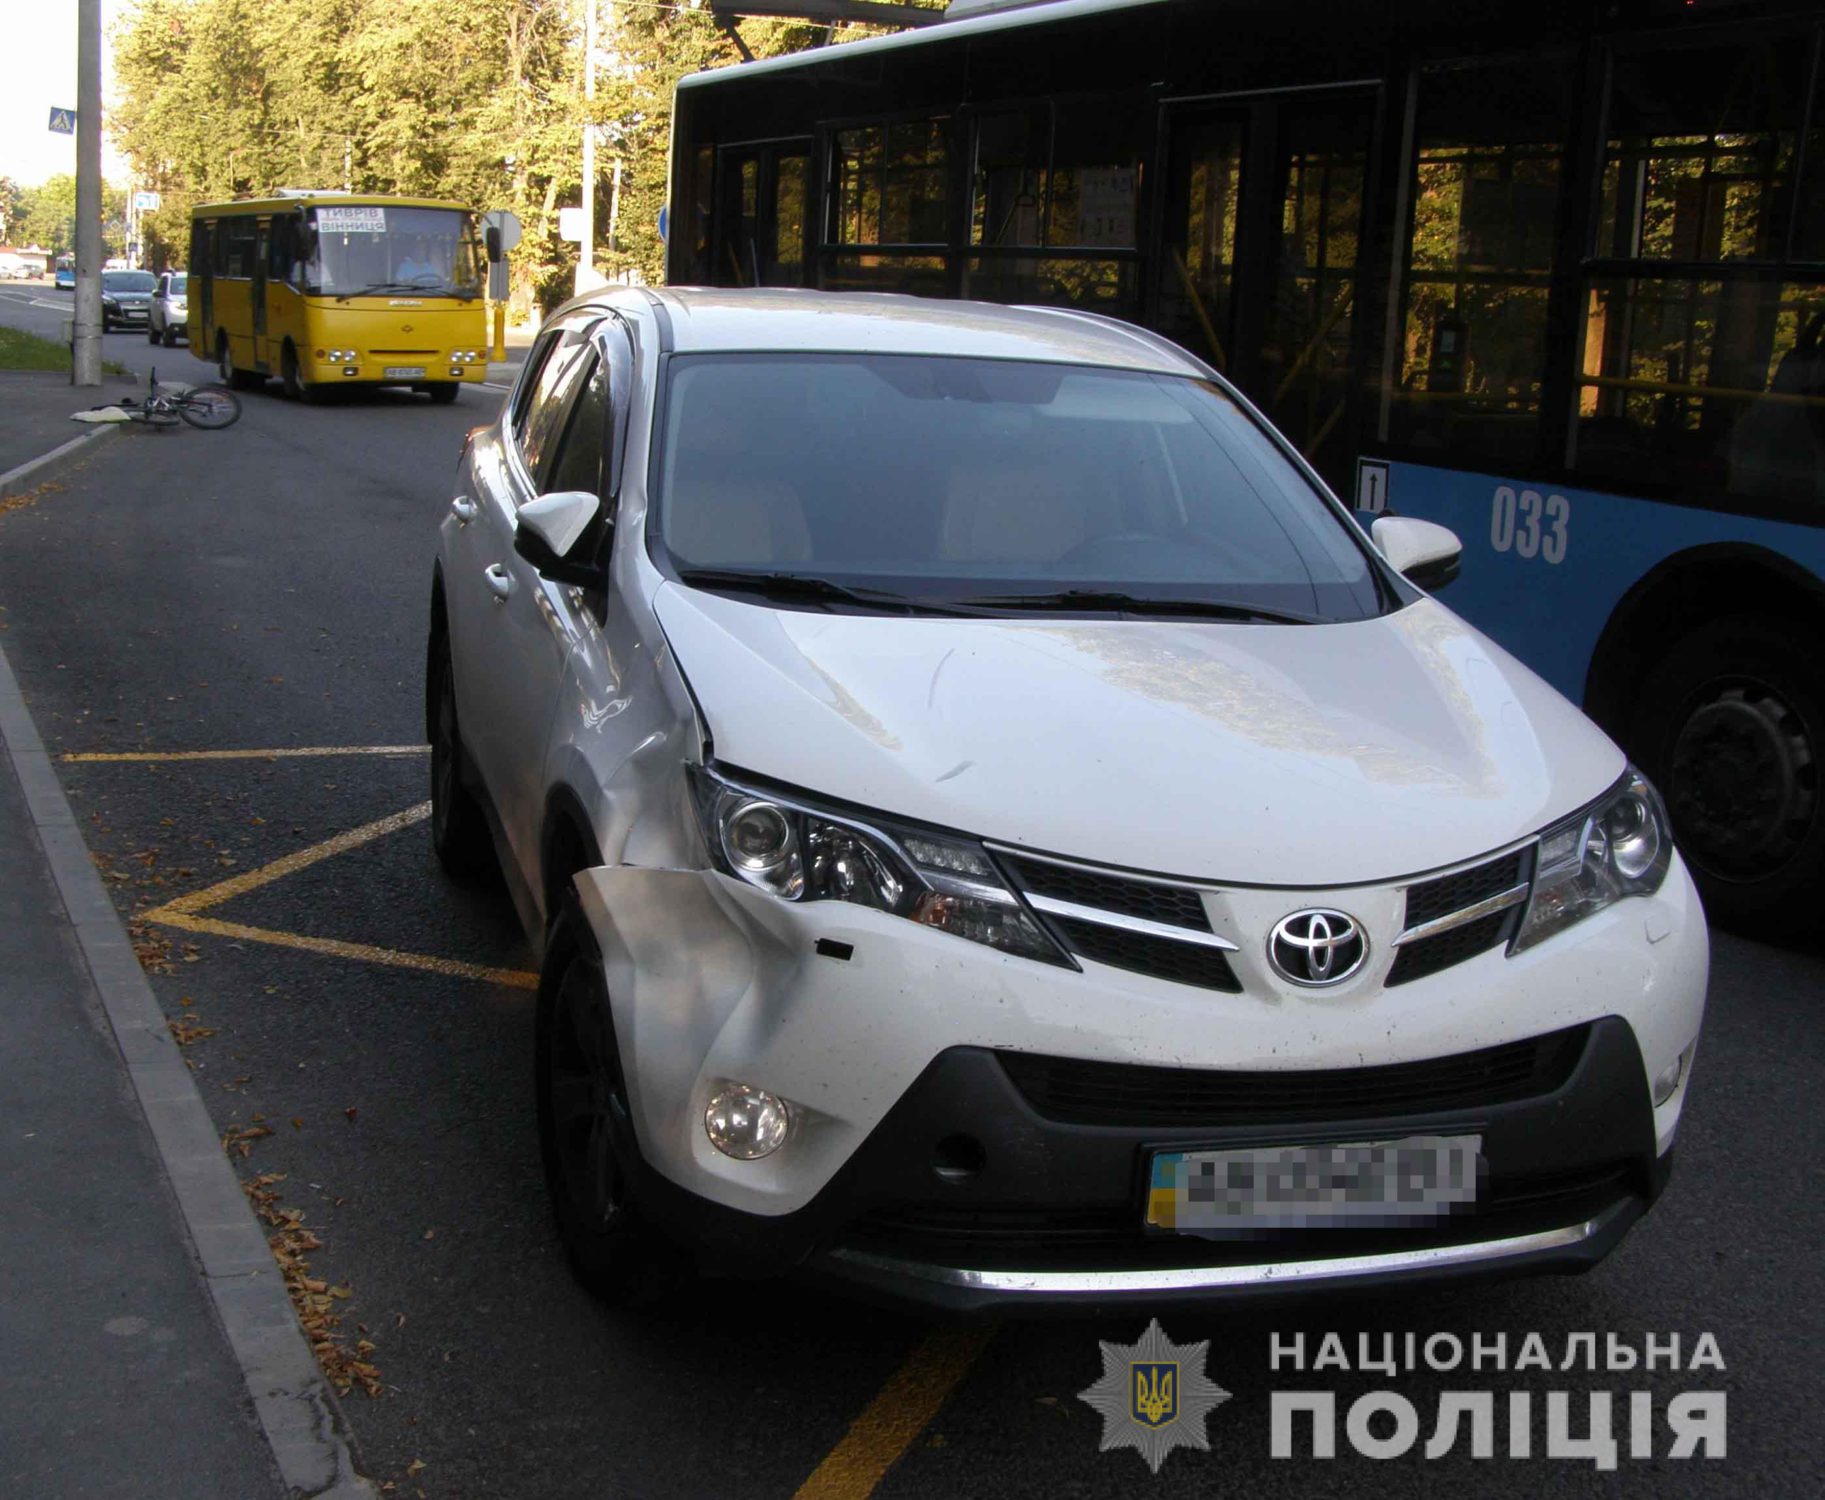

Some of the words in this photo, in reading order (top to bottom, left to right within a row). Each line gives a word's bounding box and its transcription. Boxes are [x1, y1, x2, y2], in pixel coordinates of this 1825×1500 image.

[323, 208, 378, 218] ТИВРІВ
[321, 222, 385, 231] ВІННИЦЯ
[1490, 486, 1570, 564] 033
